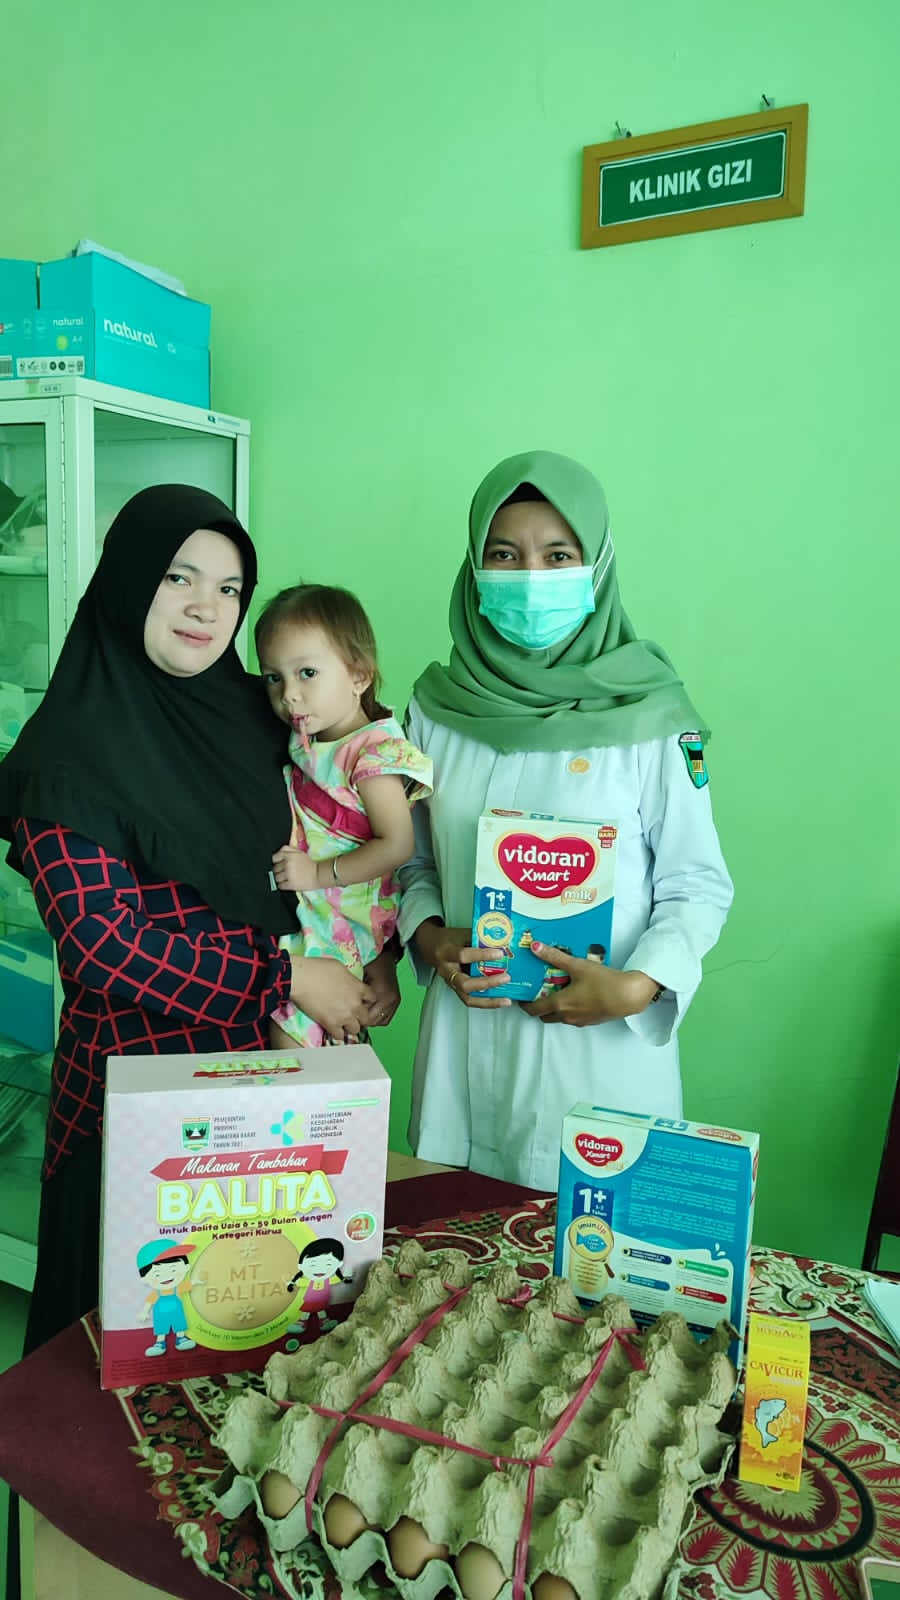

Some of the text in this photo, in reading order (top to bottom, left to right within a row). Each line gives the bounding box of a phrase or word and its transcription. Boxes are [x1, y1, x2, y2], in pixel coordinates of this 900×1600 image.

[629, 158, 753, 204] KLINIK GIZI
[53, 317, 84, 327] natural
[503, 844, 586, 868] vidoran
[519, 868, 570, 882] Xmart
[486, 891, 506, 910] 1+
[564, 889, 592, 901] milk
[577, 1138, 618, 1153] vidoran
[585, 1150, 611, 1160] Xmart
[180, 1151, 308, 1177] Makanan Tambahan
[157, 1170, 336, 1225] BALITA
[579, 1188, 607, 1213] 1+
[159, 1225, 189, 1235] Untuk
[190, 1222, 219, 1233] Balita
[271, 1216, 297, 1226] Bulan
[299, 1213, 333, 1223] dengan
[212, 1226, 282, 1241] Kategori Kurus
[352, 1217, 369, 1231] 21
[229, 1264, 263, 1283] MT
[205, 1283, 281, 1305] BALITA
[750, 1360, 804, 1379] CAVICUR
